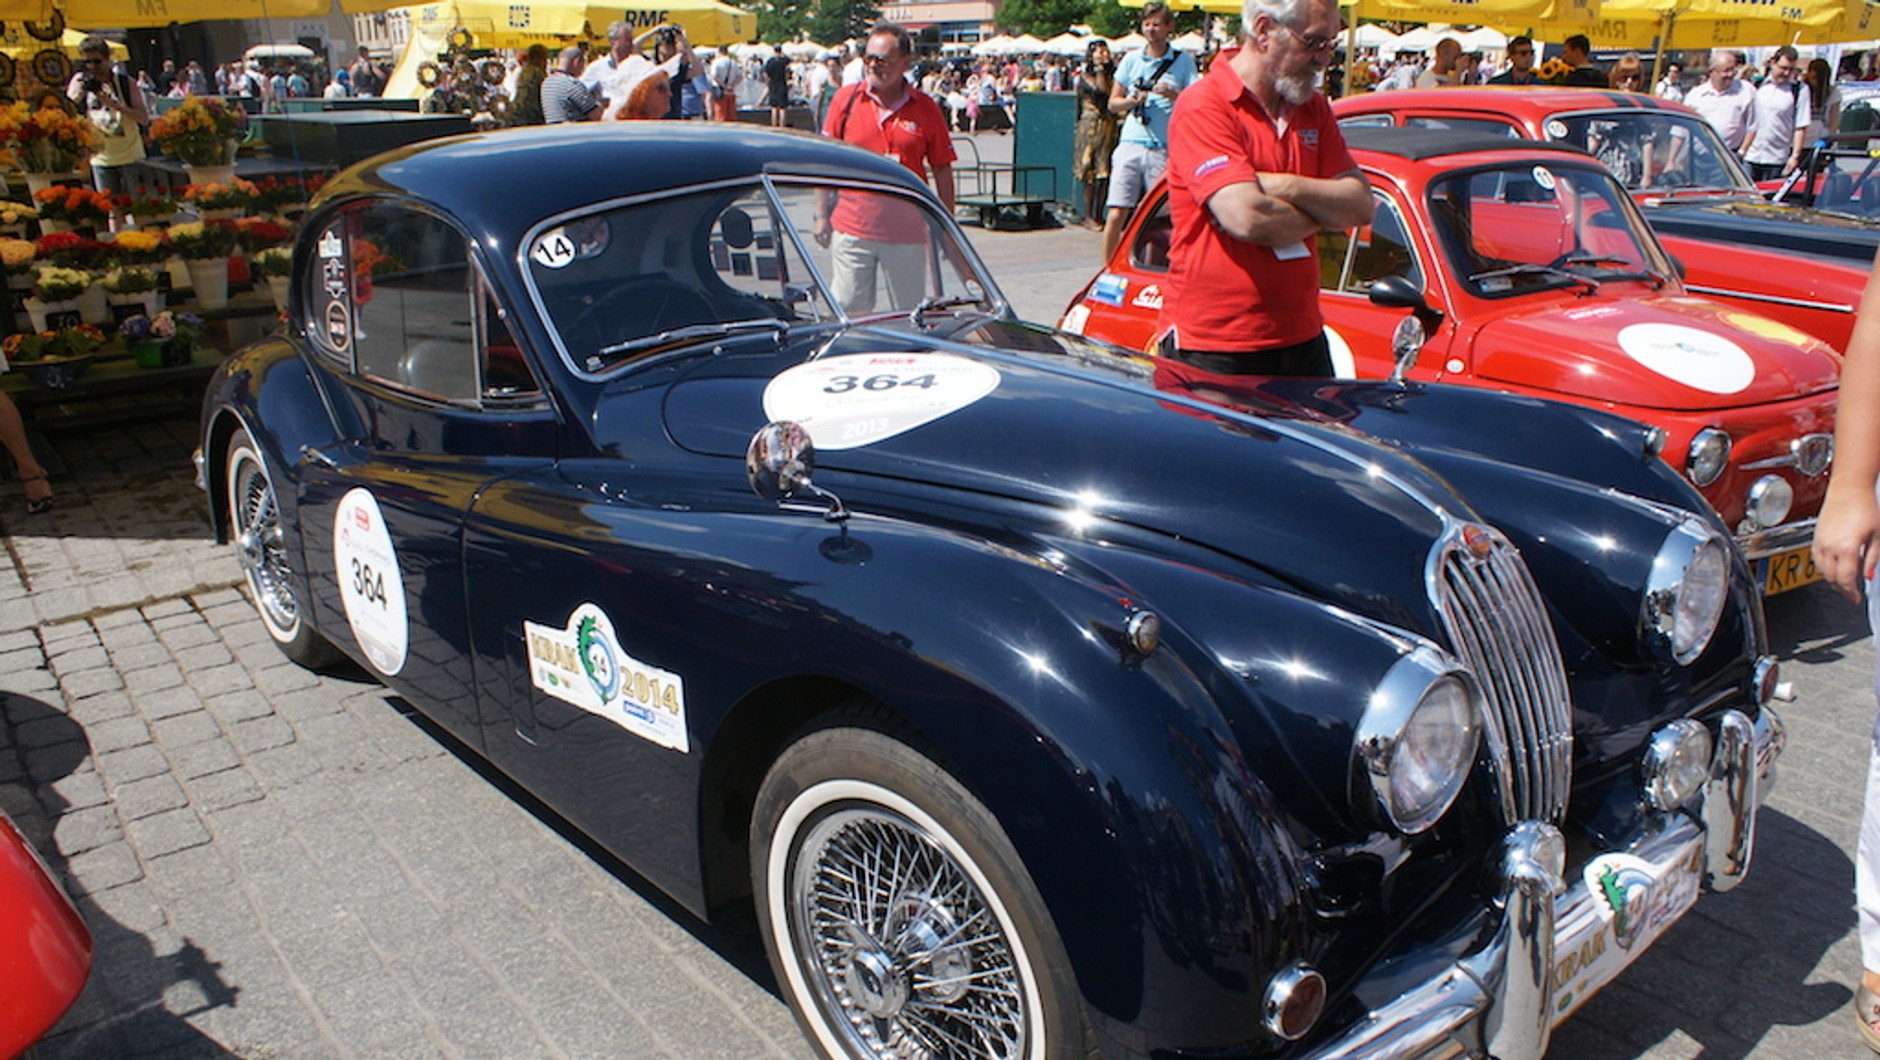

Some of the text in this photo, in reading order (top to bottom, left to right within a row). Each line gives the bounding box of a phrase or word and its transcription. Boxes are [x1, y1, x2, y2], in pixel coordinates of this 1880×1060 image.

[625, 10, 670, 27] RMF
[1781, 7, 1803, 18] FM
[537, 238, 571, 263] 14
[823, 373, 939, 394] 364
[843, 416, 889, 439] 2013
[351, 557, 388, 611] 364
[1769, 553, 1800, 591] KR
[531, 633, 579, 674] KRAK
[620, 665, 680, 716] 2014
